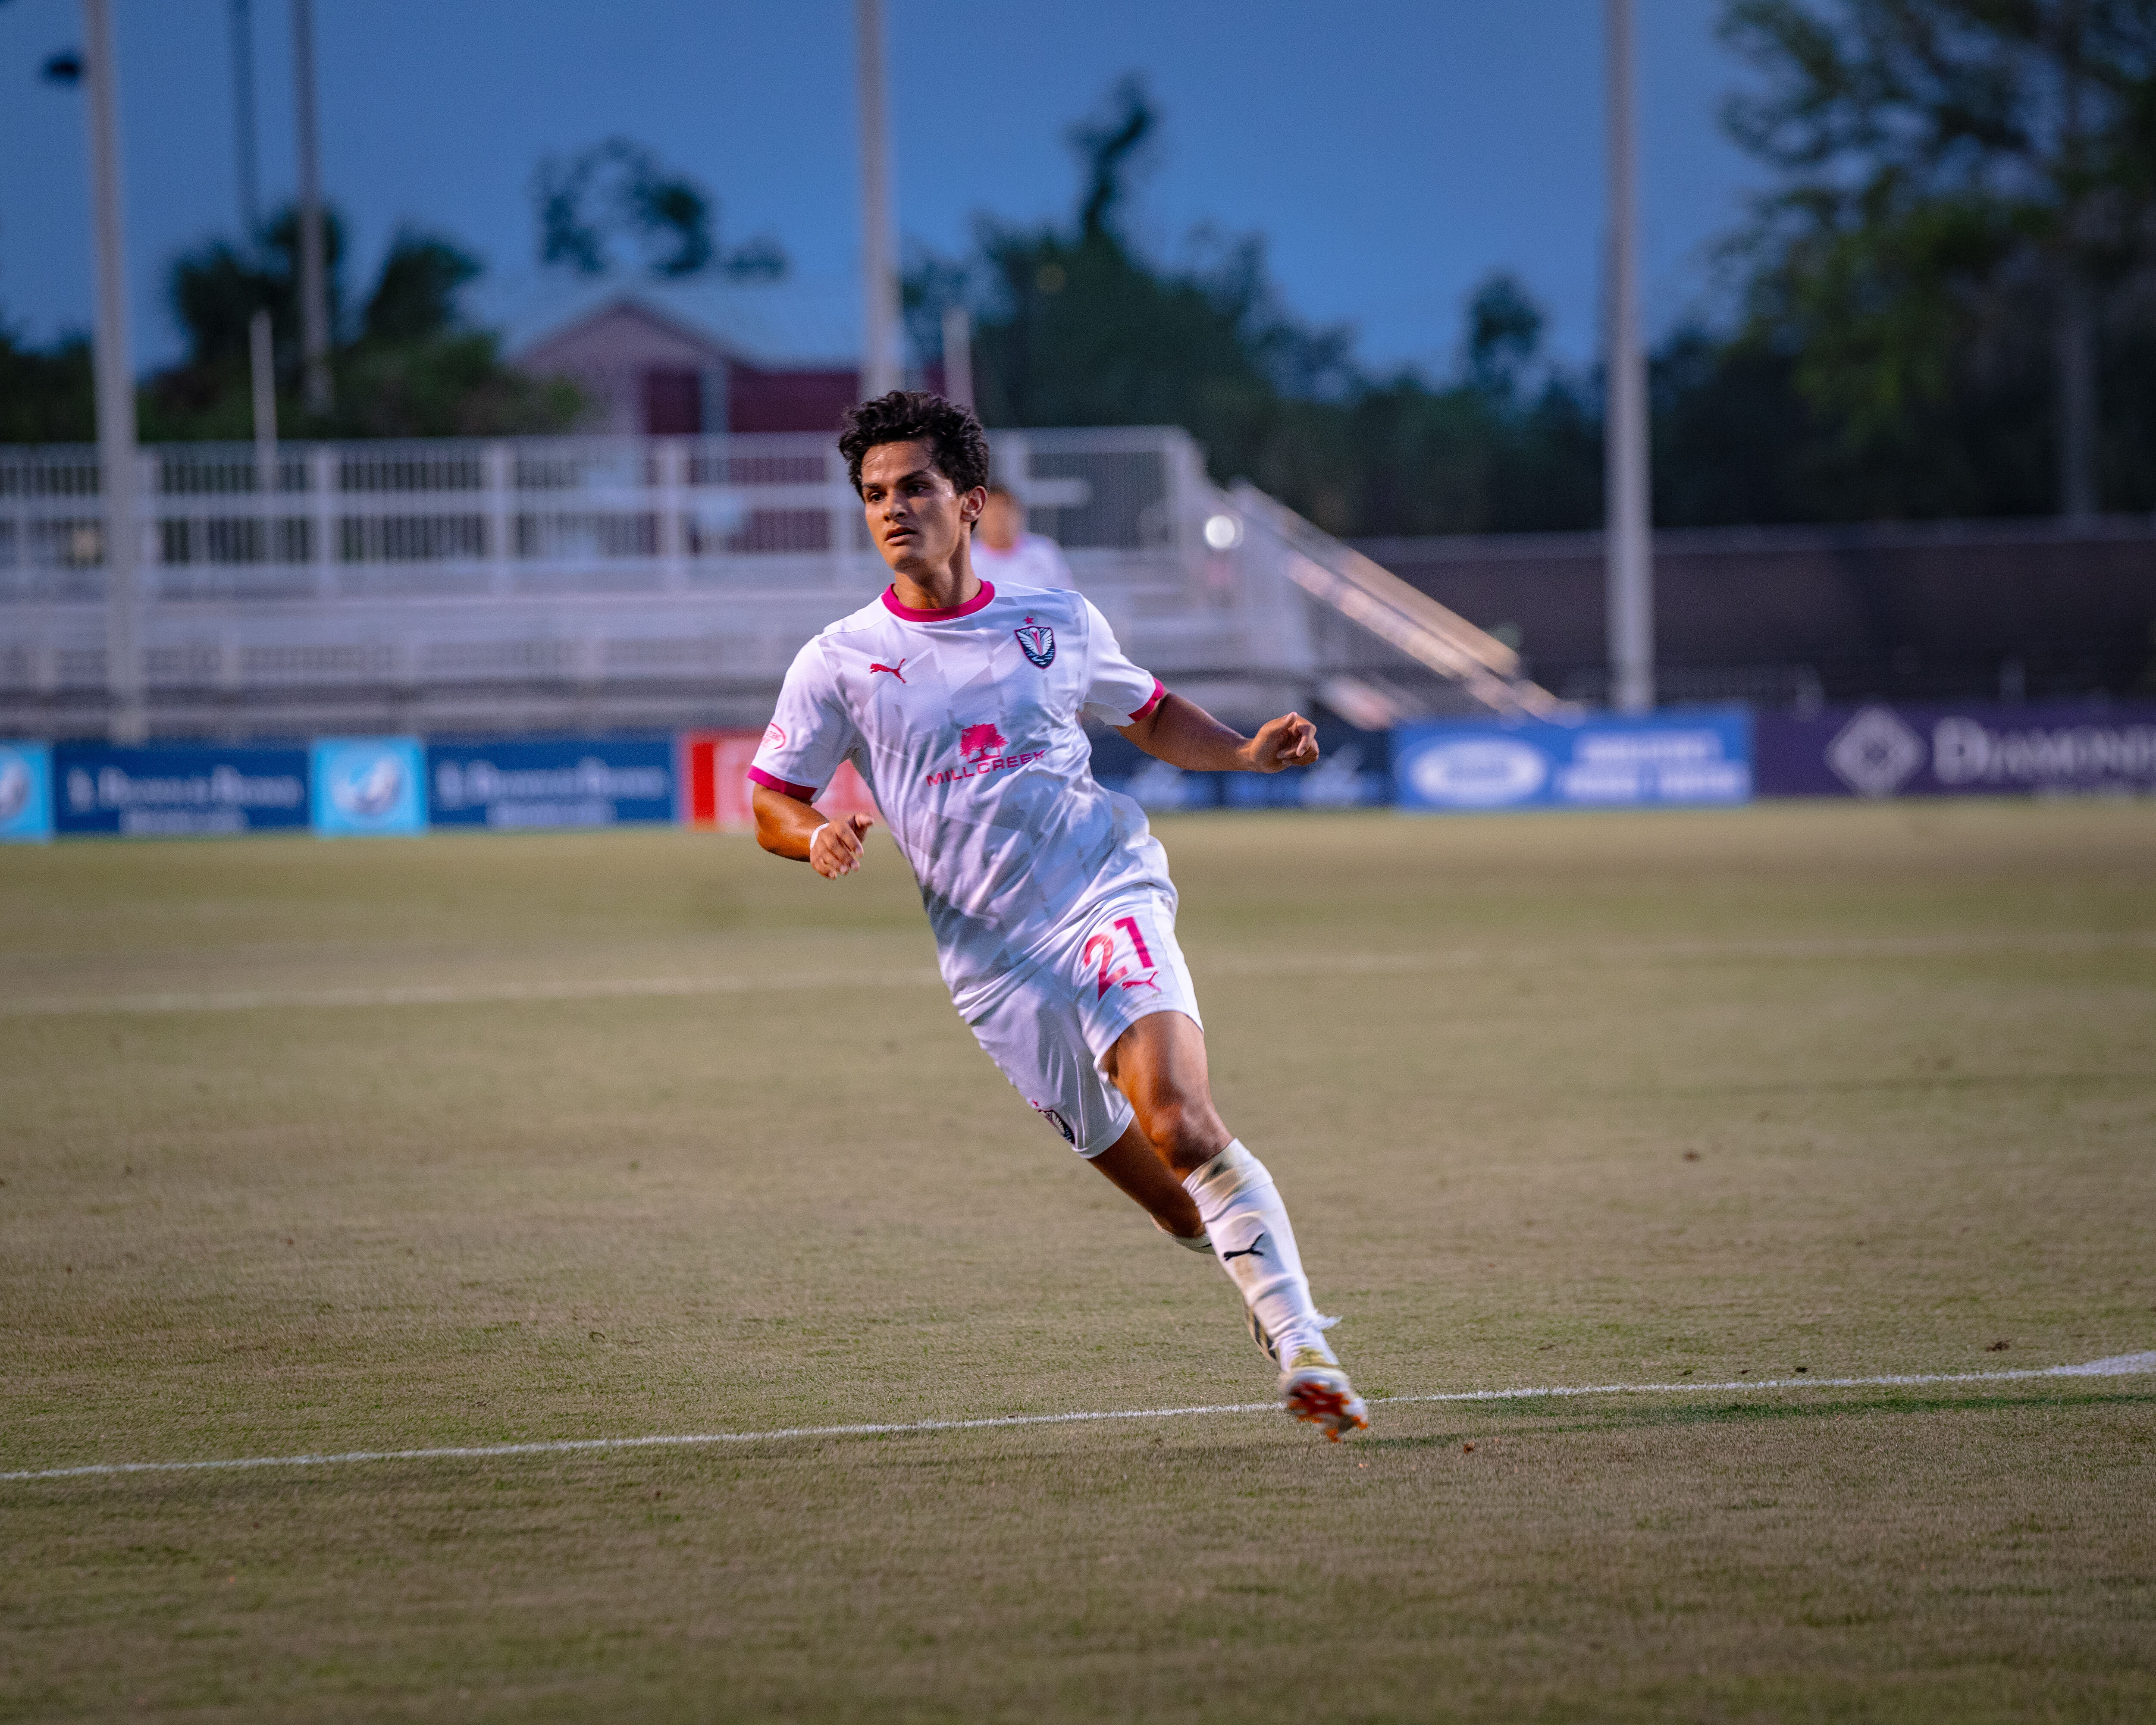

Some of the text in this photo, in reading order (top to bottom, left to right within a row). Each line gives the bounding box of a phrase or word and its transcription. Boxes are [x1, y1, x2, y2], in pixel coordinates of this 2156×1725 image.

[926, 749, 1046, 787] MILL CREEK
[1084, 916, 1154, 1003] 21
